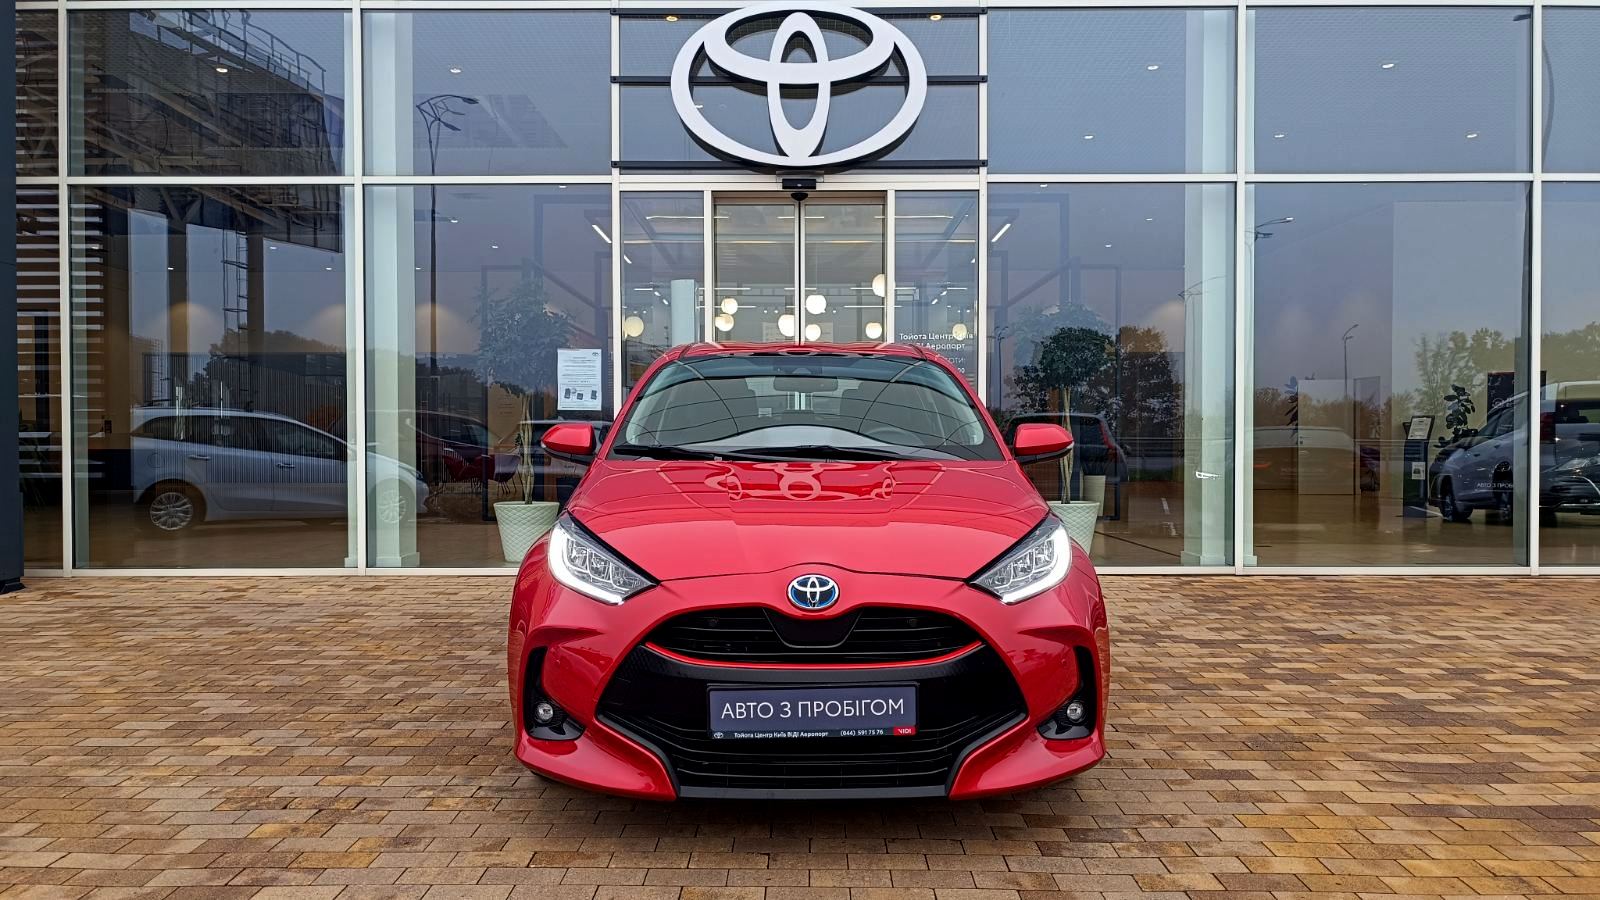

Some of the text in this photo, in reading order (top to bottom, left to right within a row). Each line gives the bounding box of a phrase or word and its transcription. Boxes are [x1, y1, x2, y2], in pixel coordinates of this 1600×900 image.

[721, 698, 904, 719] АВТО З ПРОБІГОМ
